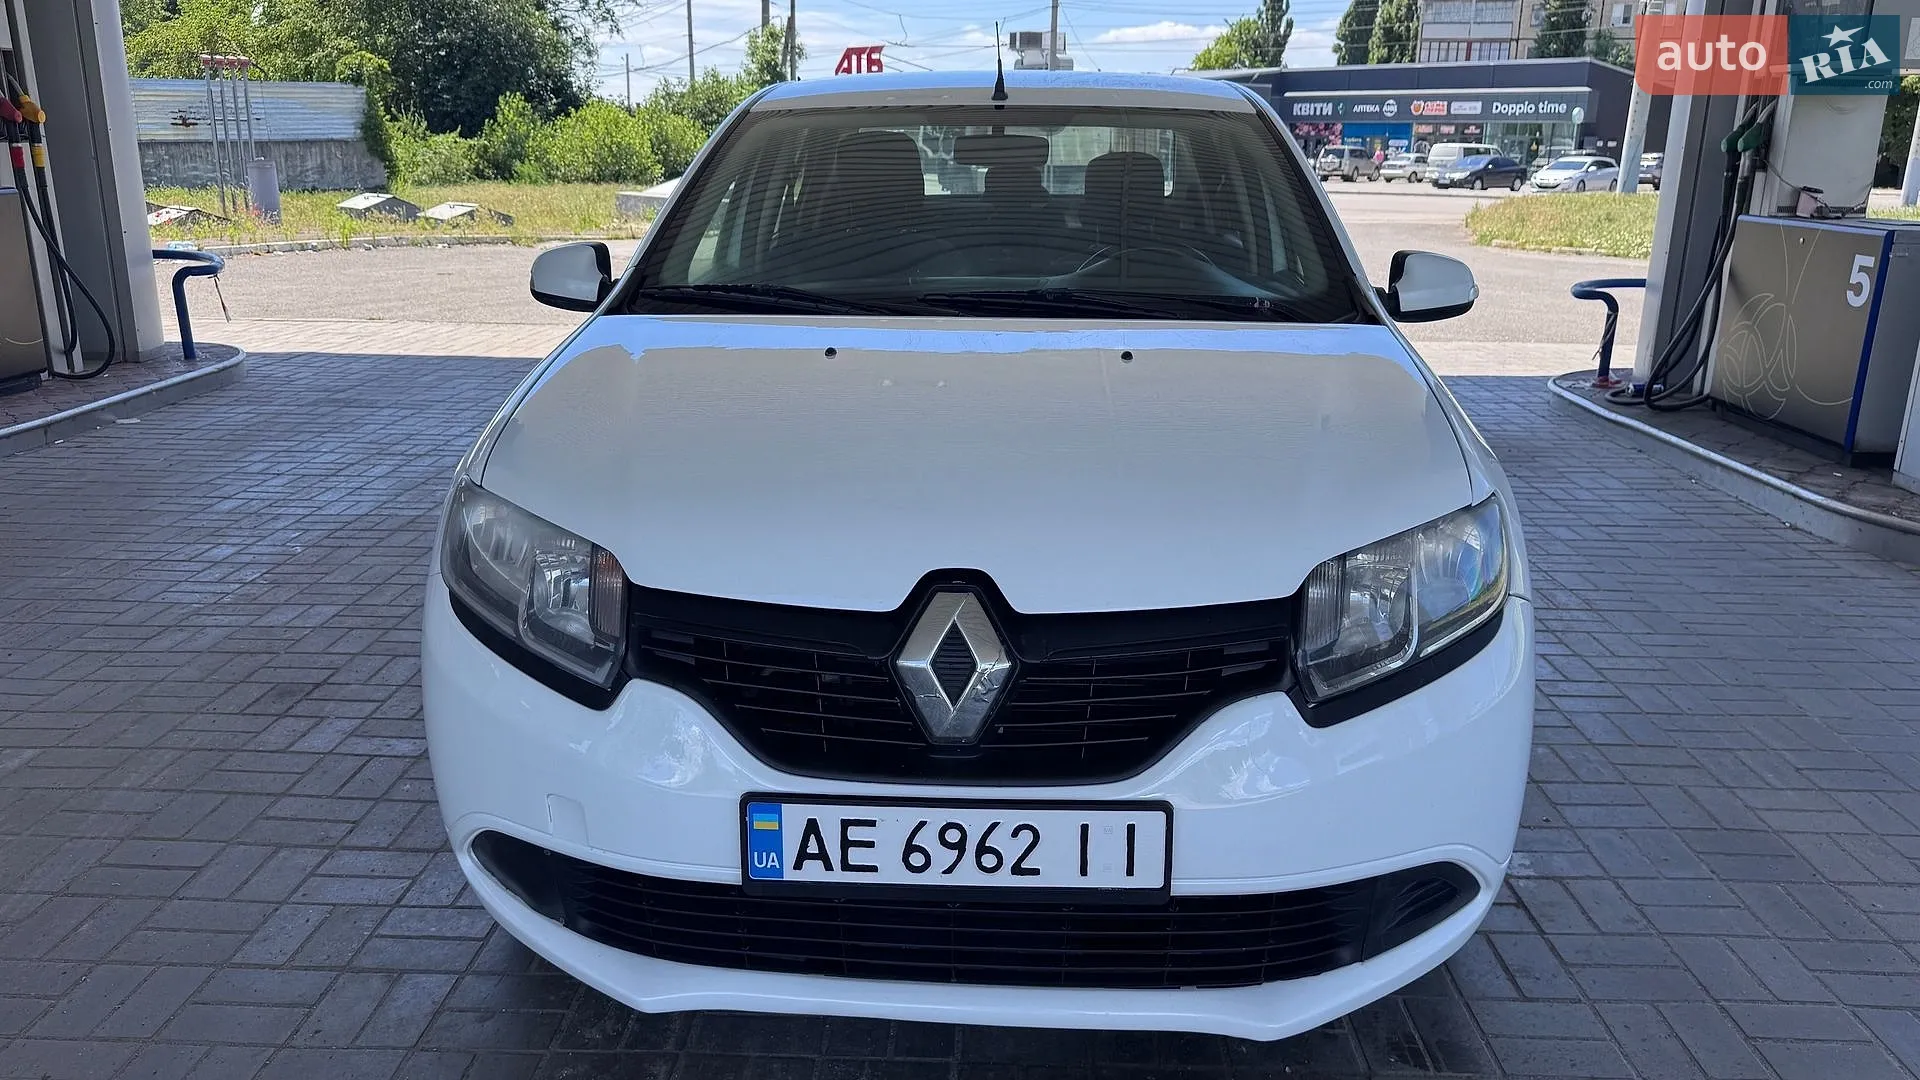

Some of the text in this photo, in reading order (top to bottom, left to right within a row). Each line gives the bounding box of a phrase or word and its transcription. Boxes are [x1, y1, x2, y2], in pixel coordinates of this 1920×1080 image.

[835, 46, 885, 76] АТБ
[1293, 102, 1333, 116] КВІТИ
[1352, 104, 1380, 113] АПТЕКА
[1492, 101, 1535, 116] Doppio
[1538, 101, 1567, 114] time
[1846, 254, 1875, 308] 5
[793, 817, 1136, 877] AE 6962 II
[753, 851, 780, 869] UA
